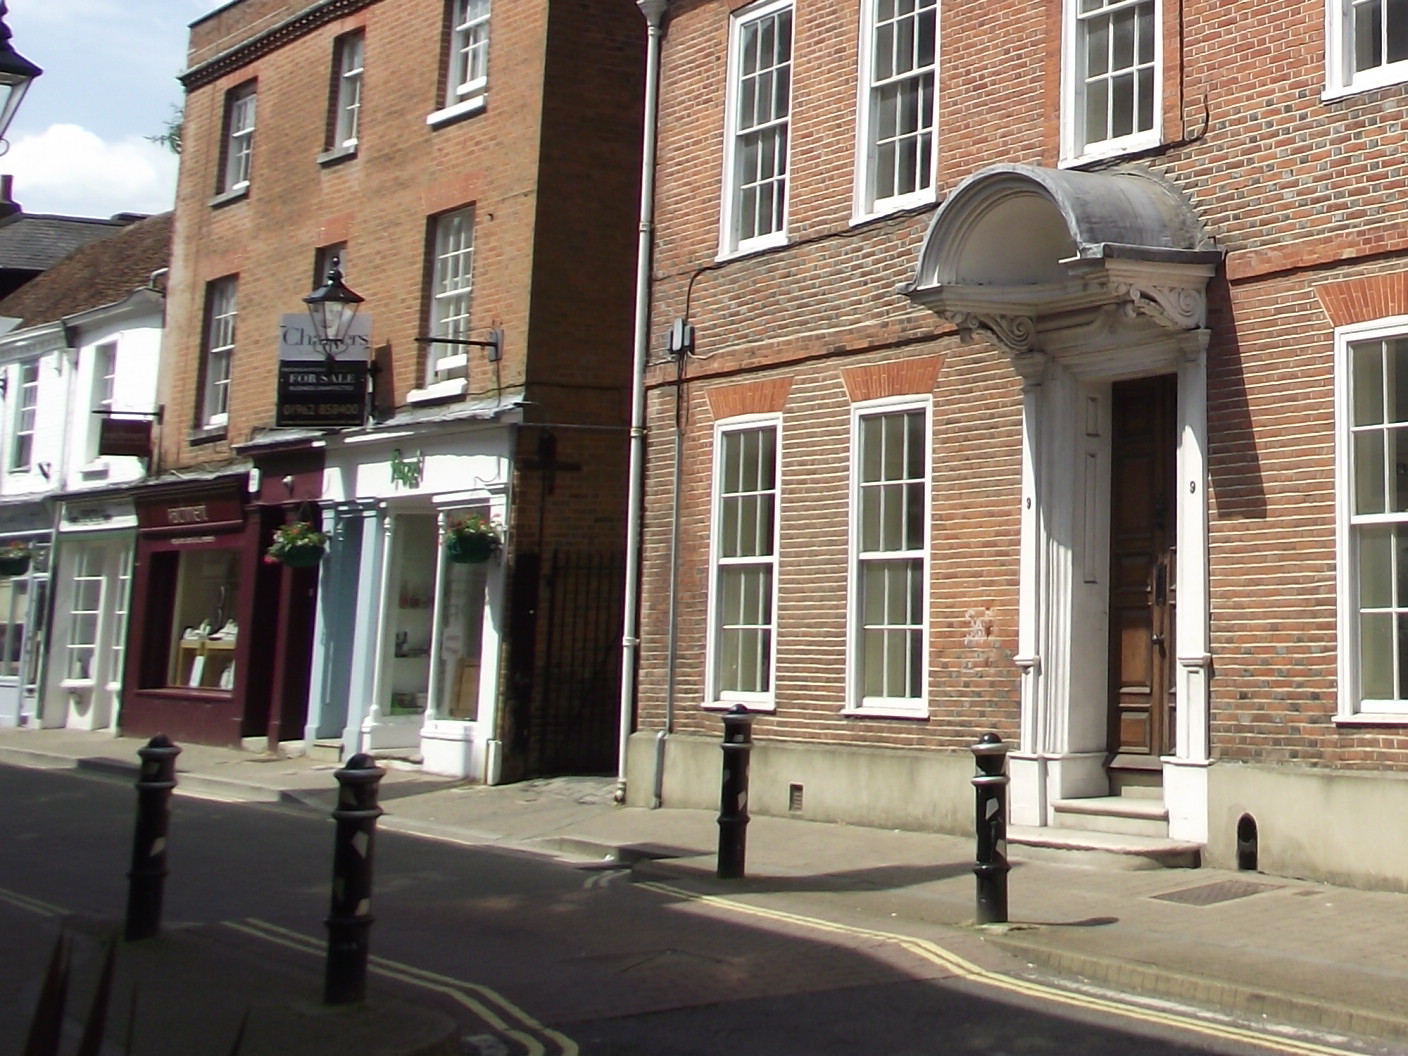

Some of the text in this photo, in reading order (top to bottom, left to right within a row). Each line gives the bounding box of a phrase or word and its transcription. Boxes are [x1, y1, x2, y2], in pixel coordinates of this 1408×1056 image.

[289, 373, 356, 384] FOR SALE
[1189, 480, 1195, 494] 9
[1026, 497, 1031, 510] 9
